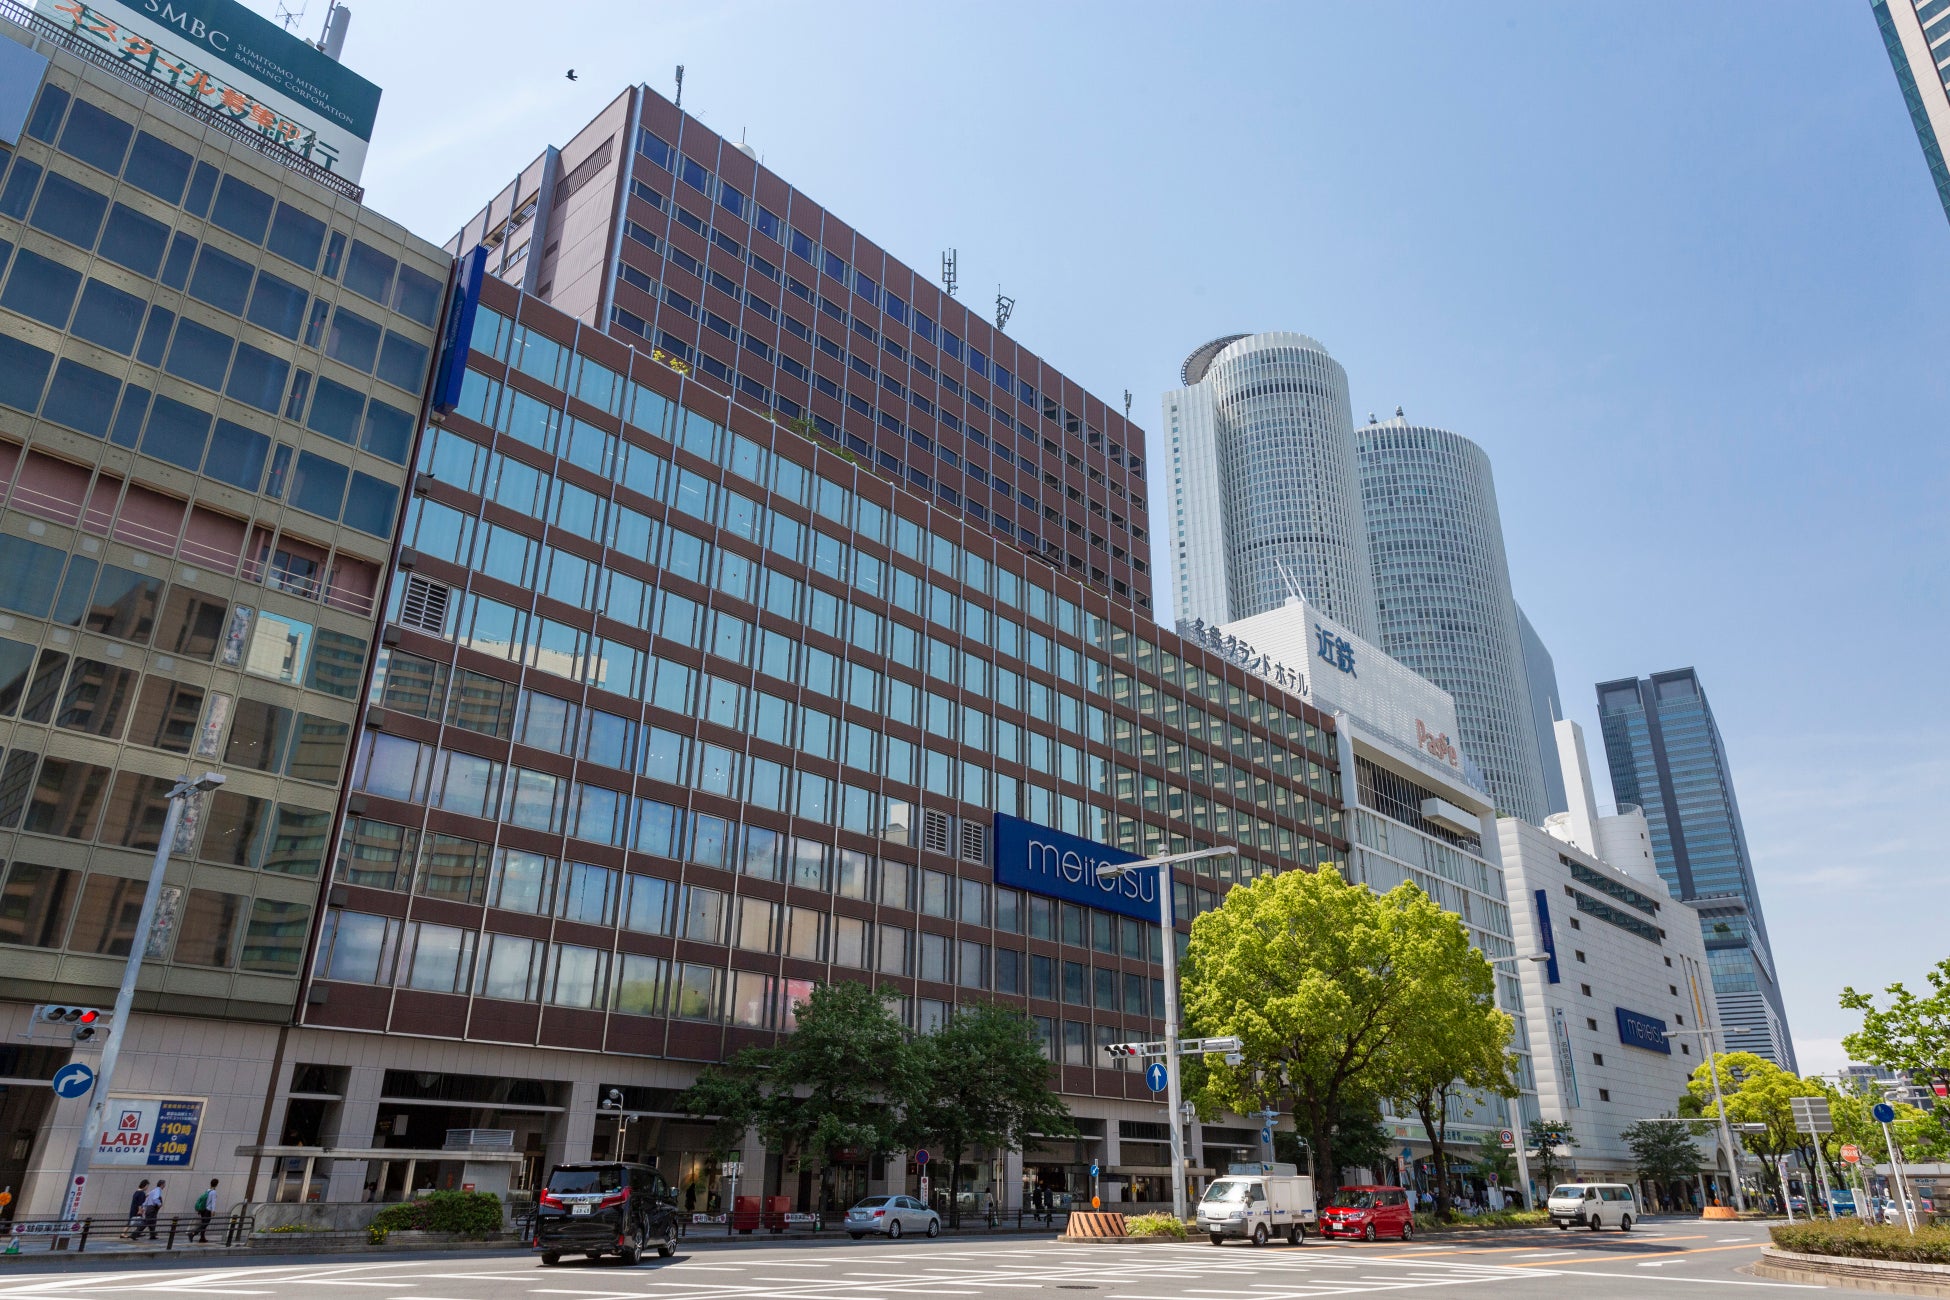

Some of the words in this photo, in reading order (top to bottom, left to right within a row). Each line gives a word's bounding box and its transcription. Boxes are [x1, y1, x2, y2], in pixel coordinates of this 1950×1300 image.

[144, 0, 229, 52] SMBC
[234, 52, 282, 83] BANKING
[285, 81, 354, 124] CORPORATION
[237, 43, 294, 80] SUMITOMO
[296, 77, 329, 101] MITSUI
[1194, 617, 1308, 697] 名鉄グランドホテル
[1314, 623, 1358, 679] 近鉄
[98, 1146, 146, 1154] NAGOYA
[100, 1131, 150, 1146] LABI
